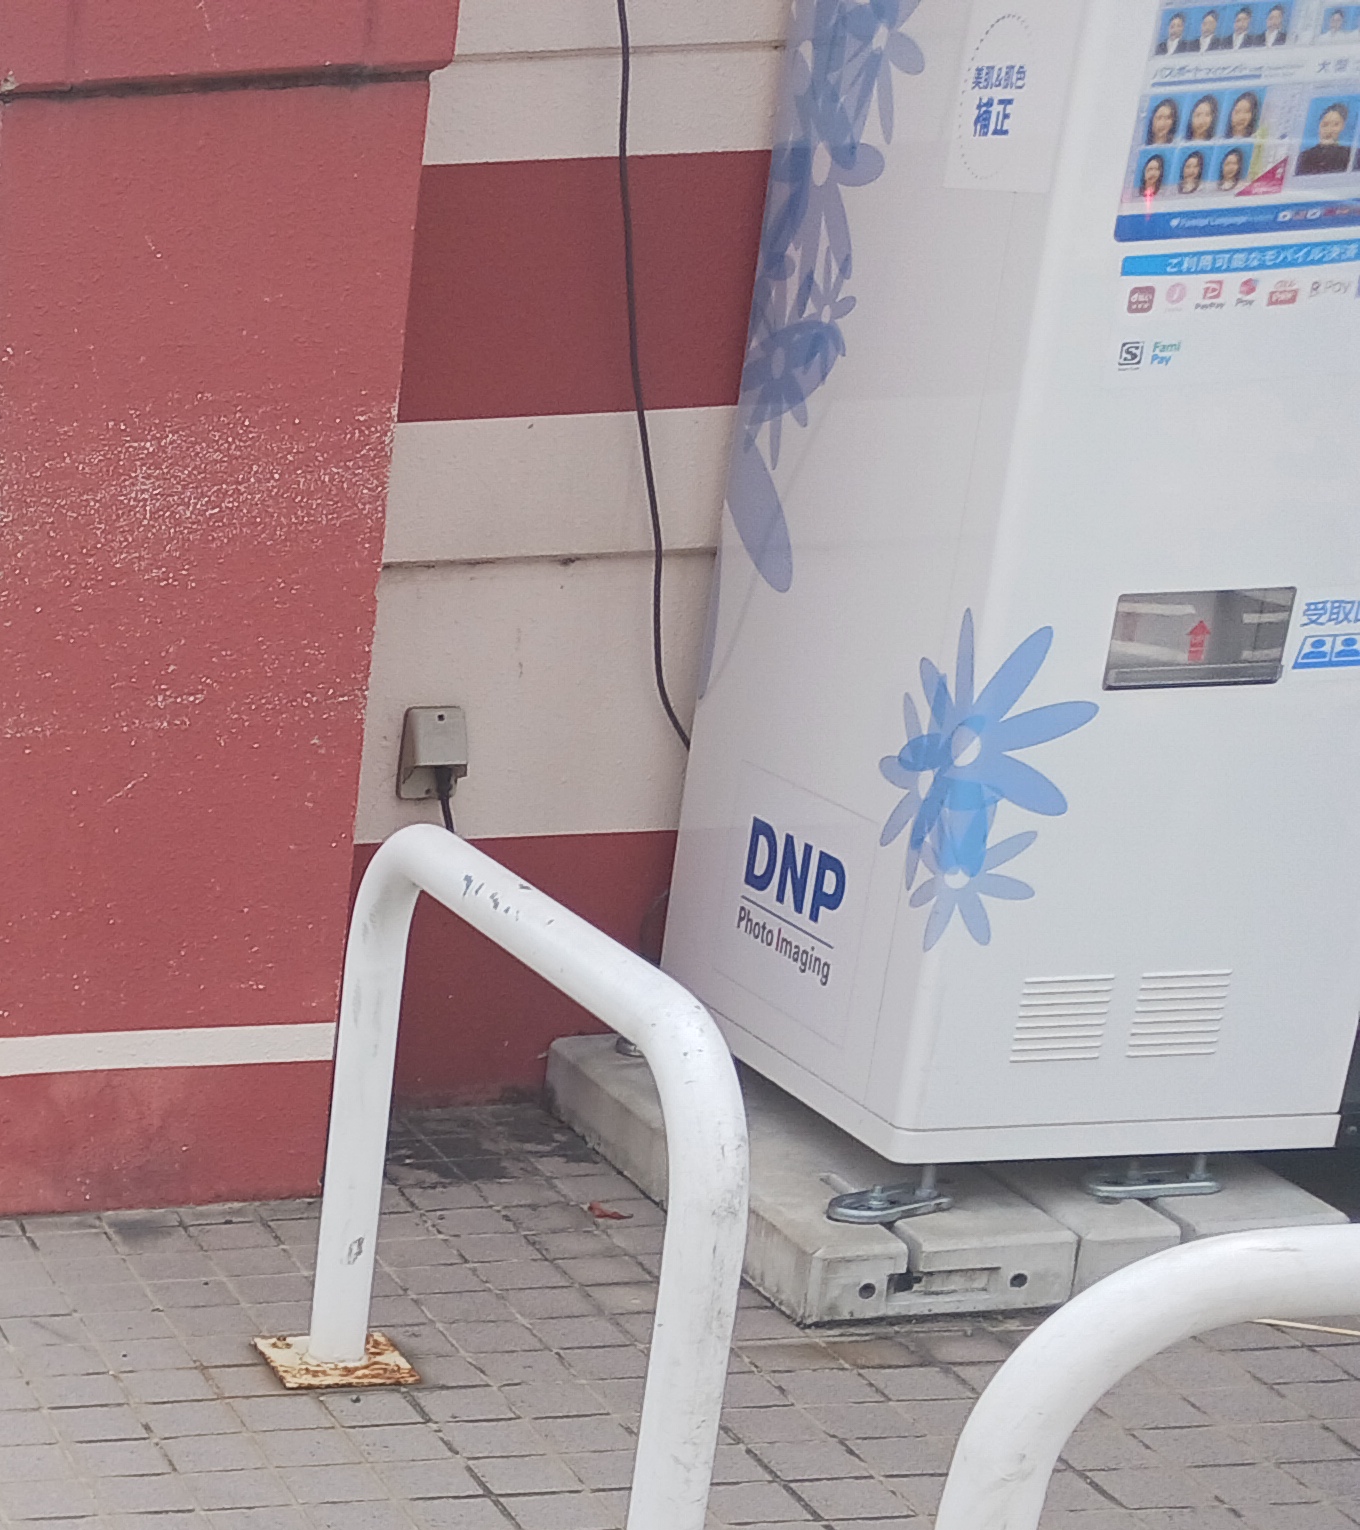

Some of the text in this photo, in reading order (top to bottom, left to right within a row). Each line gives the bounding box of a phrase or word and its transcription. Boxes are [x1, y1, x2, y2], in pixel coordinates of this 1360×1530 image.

[971, 65, 1026, 90] 美肌&肌色
[973, 96, 1014, 137] 補正
[1150, 353, 1172, 366] Pay
[1152, 341, 1182, 353] Fami
[1299, 600, 1360, 627] 受取
[744, 816, 846, 924] DNP
[737, 906, 831, 986] Photo Imaging
